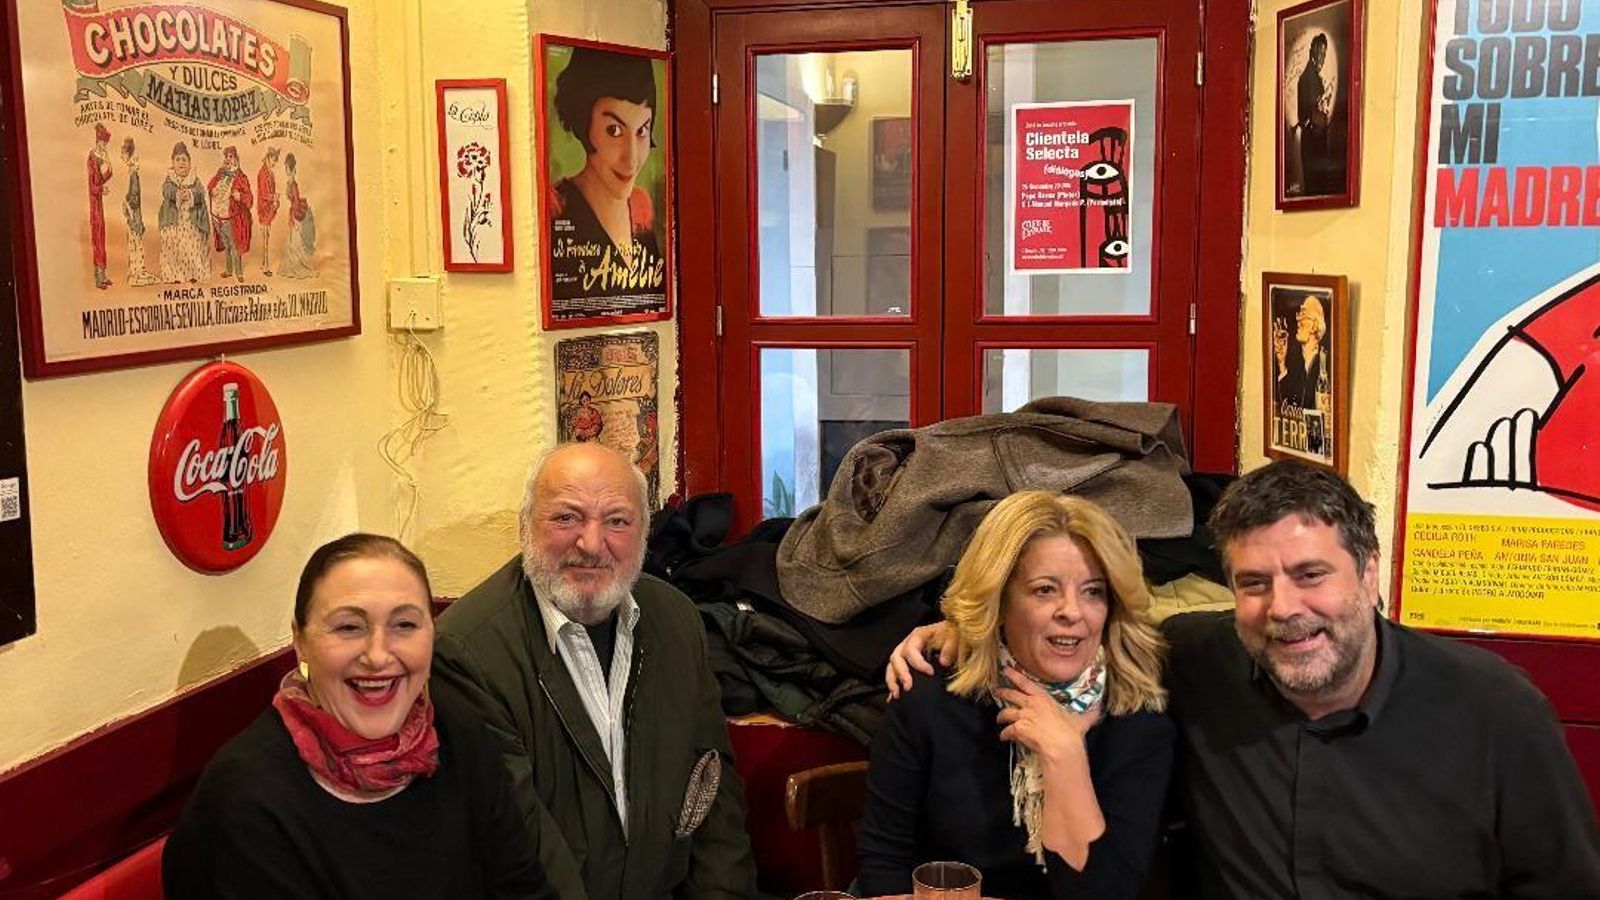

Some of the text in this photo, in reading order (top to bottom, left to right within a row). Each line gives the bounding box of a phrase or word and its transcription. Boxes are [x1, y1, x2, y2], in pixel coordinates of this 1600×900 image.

[84, 9, 277, 78] CHOCOLATES
[169, 66, 238, 92] Y DULCES
[146, 75, 211, 121] MATIAS
[1026, 130, 1090, 146] Clientela
[1437, 102, 1501, 165] MI
[1026, 146, 1079, 160] Selecta
[163, 288, 205, 301] MARCA
[590, 367, 642, 398] Dolores
[1541, 539, 1586, 552] PAREDES
[1562, 554, 1589, 565] JUAN
